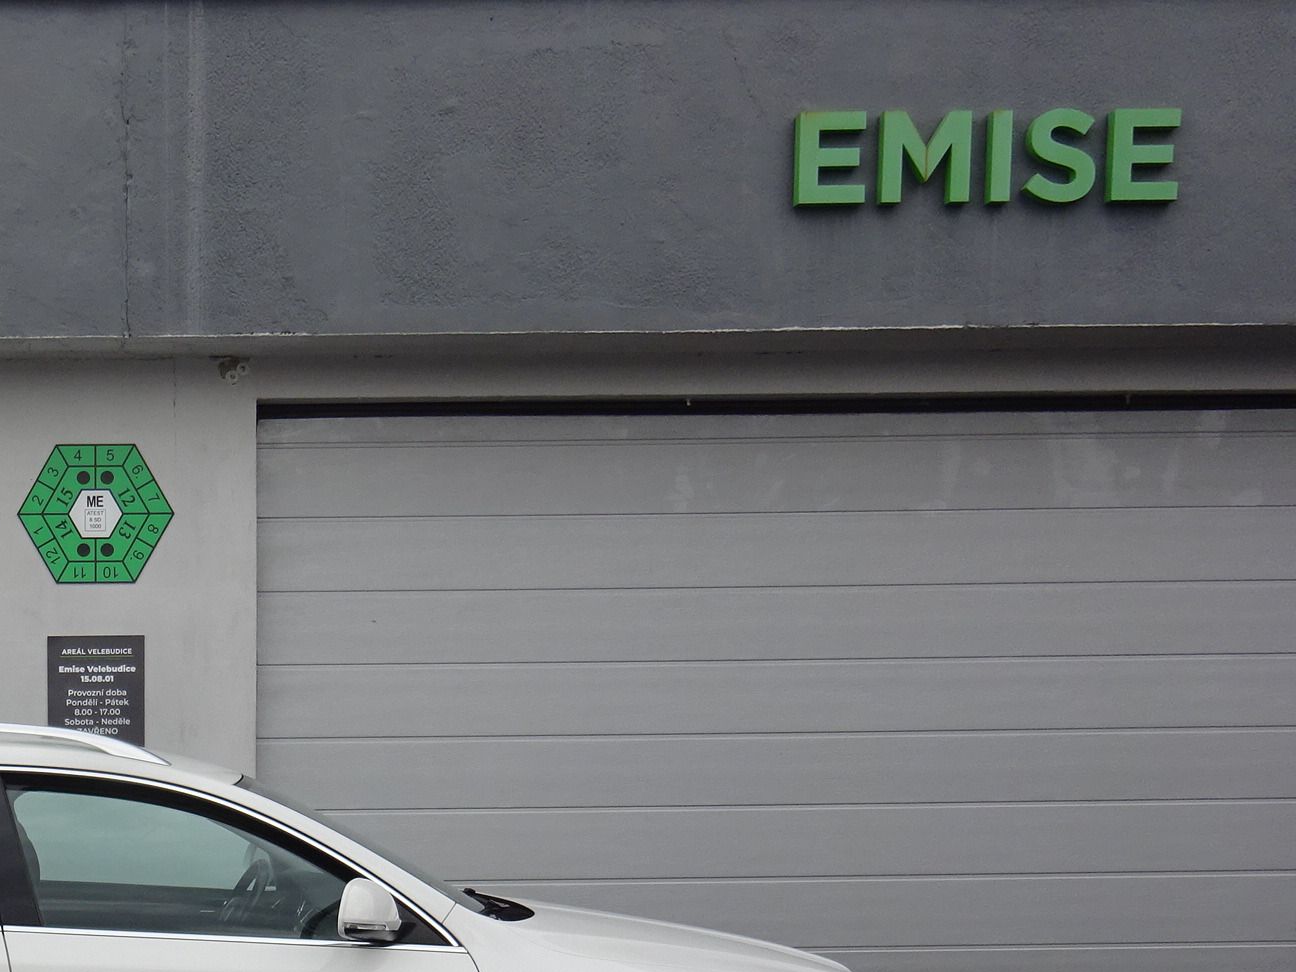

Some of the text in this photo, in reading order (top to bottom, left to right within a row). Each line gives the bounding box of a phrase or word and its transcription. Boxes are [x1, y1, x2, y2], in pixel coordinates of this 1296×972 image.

[793, 107, 1183, 208] EMISE
[74, 449, 82, 461] 4
[107, 450, 114, 461] 5
[48, 467, 59, 477] 3
[32, 495, 43, 506] 2
[56, 488, 73, 507] 15
[87, 496, 104, 507] ME
[118, 488, 135, 507] 12
[148, 493, 160, 502] 7
[34, 526, 43, 534] 1
[55, 520, 72, 539] 14
[119, 522, 136, 539] 13
[148, 525, 159, 534] 8
[46, 548, 61, 564] 12
[74, 568, 86, 578] 11
[103, 567, 118, 578] 10
[59, 665, 85, 673] Emise
